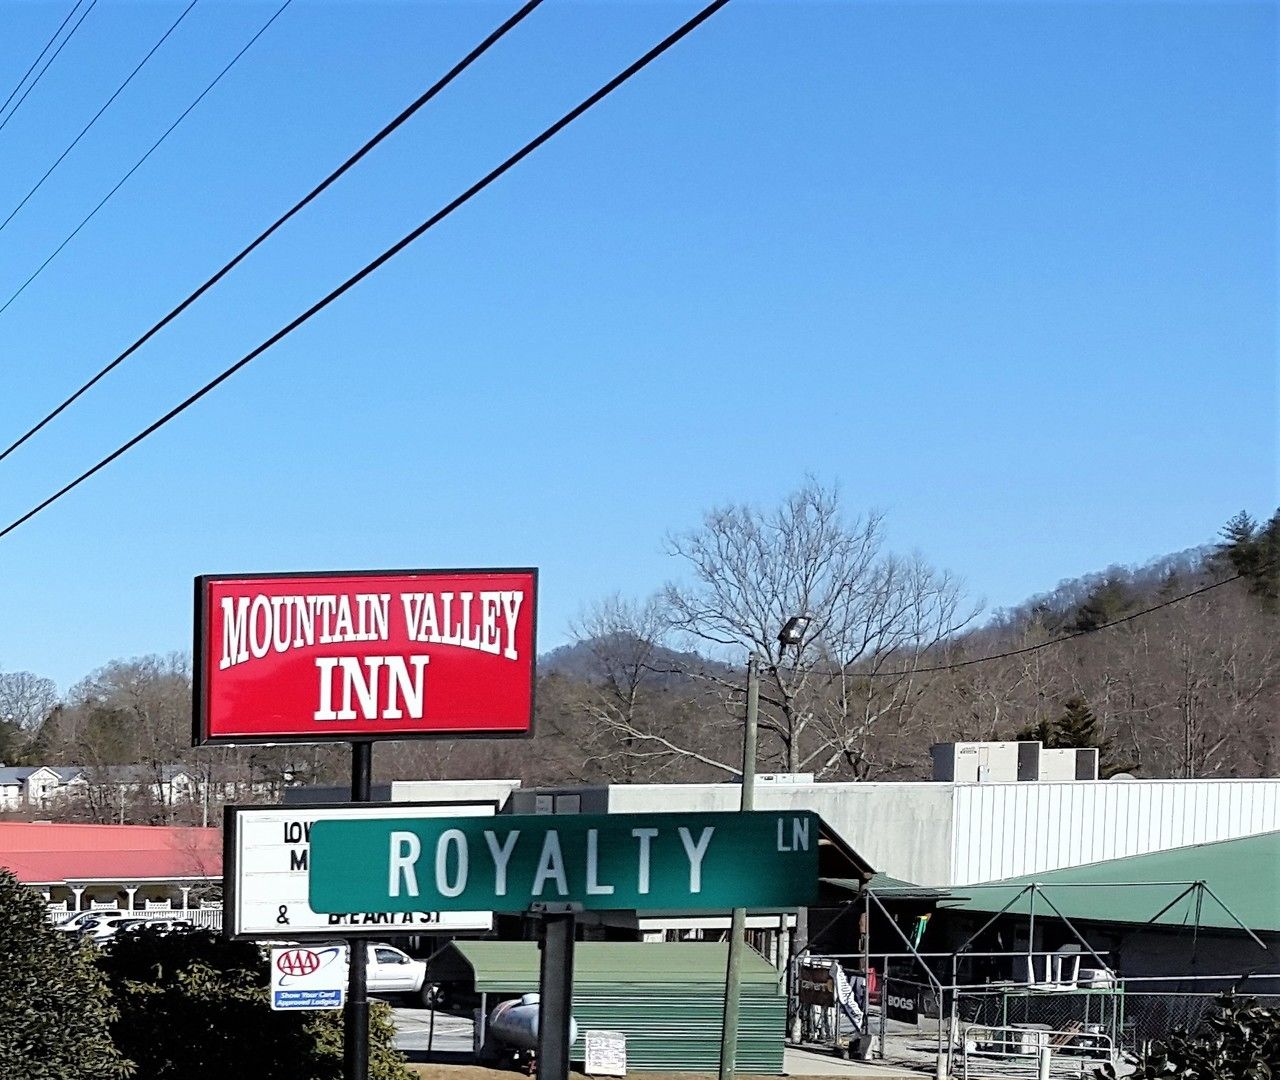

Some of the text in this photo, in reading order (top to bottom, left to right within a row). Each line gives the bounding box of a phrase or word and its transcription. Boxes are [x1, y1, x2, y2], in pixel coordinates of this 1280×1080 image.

[219, 590, 524, 671] MOUNTAIN VALLEY
[313, 655, 430, 721] INN
[388, 817, 810, 898] ROYALTY LN
[276, 904, 291, 925] &
[280, 949, 318, 976] AAA
[887, 994, 914, 1011] BOGS
